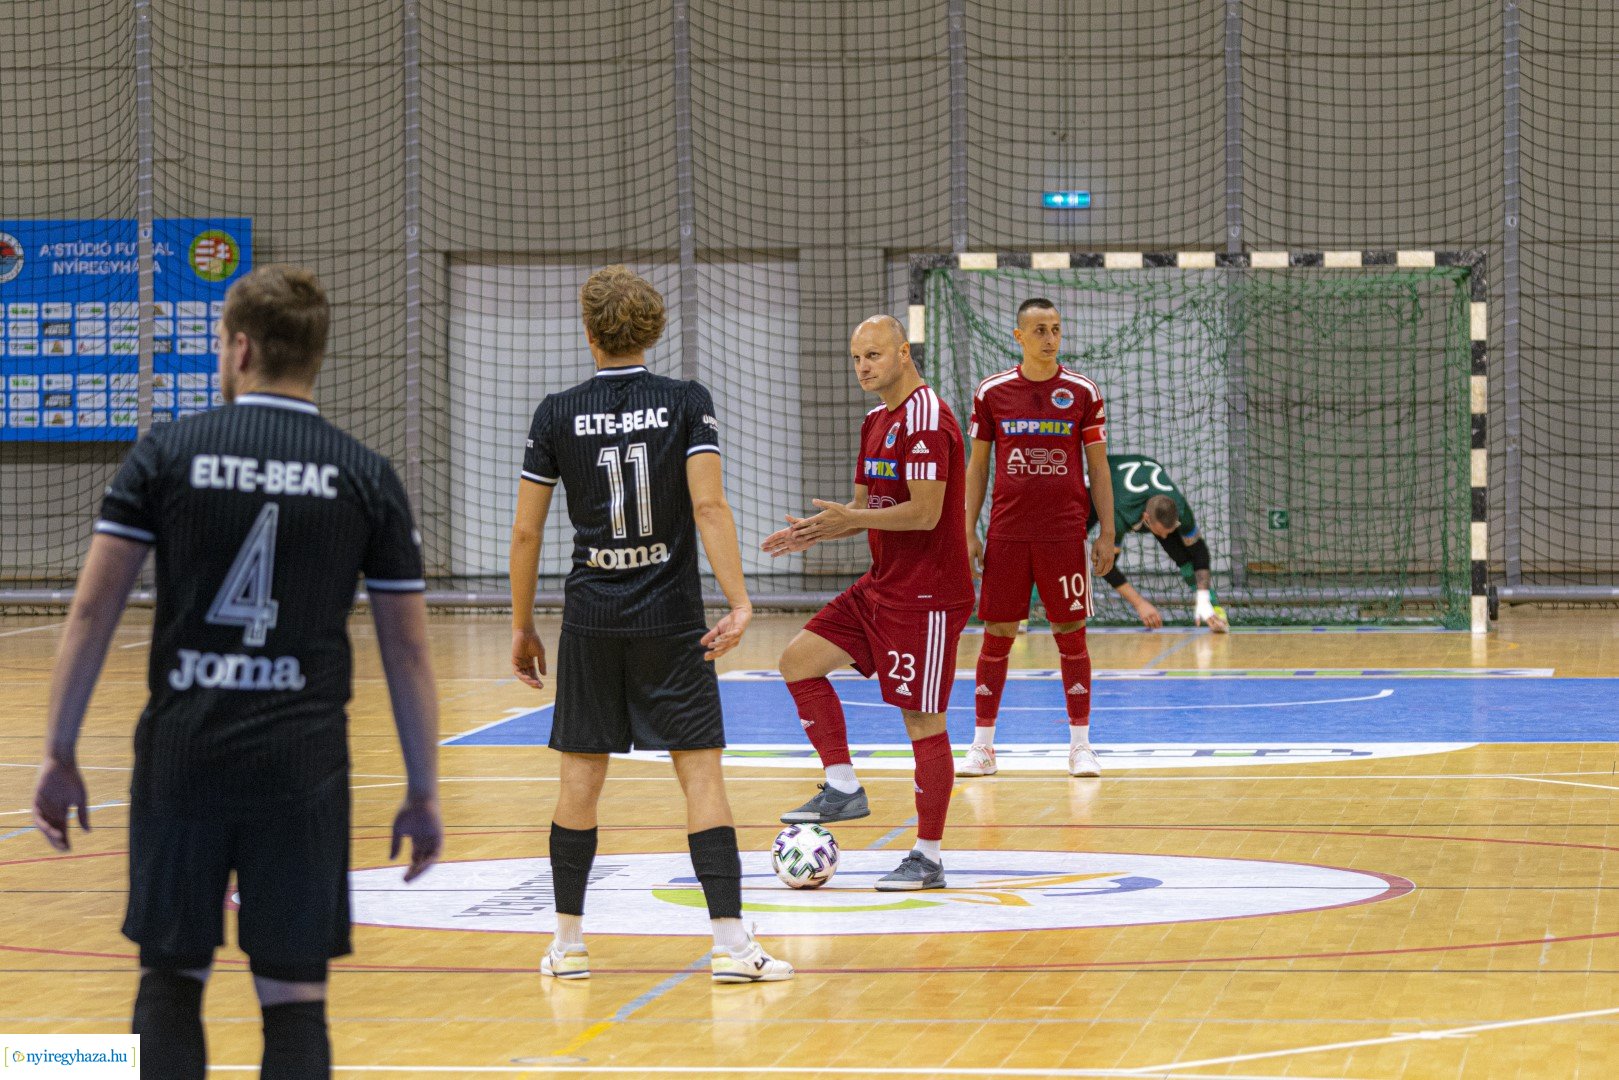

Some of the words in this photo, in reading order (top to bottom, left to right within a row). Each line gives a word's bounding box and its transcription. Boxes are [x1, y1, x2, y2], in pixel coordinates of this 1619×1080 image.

[115, 241, 174, 257] FUAL
[53, 259, 162, 276] NYÍREGYHÁA
[574, 407, 669, 437] ELTE-BEAC
[192, 454, 339, 499] ELTE-BEAC
[1007, 465, 1068, 475] STUDIO
[1118, 461, 1173, 493] 22
[597, 442, 653, 540] 11
[205, 502, 279, 647] 4
[1059, 573, 1085, 599] 10
[169, 649, 306, 691] Joma
[888, 651, 916, 682] 23
